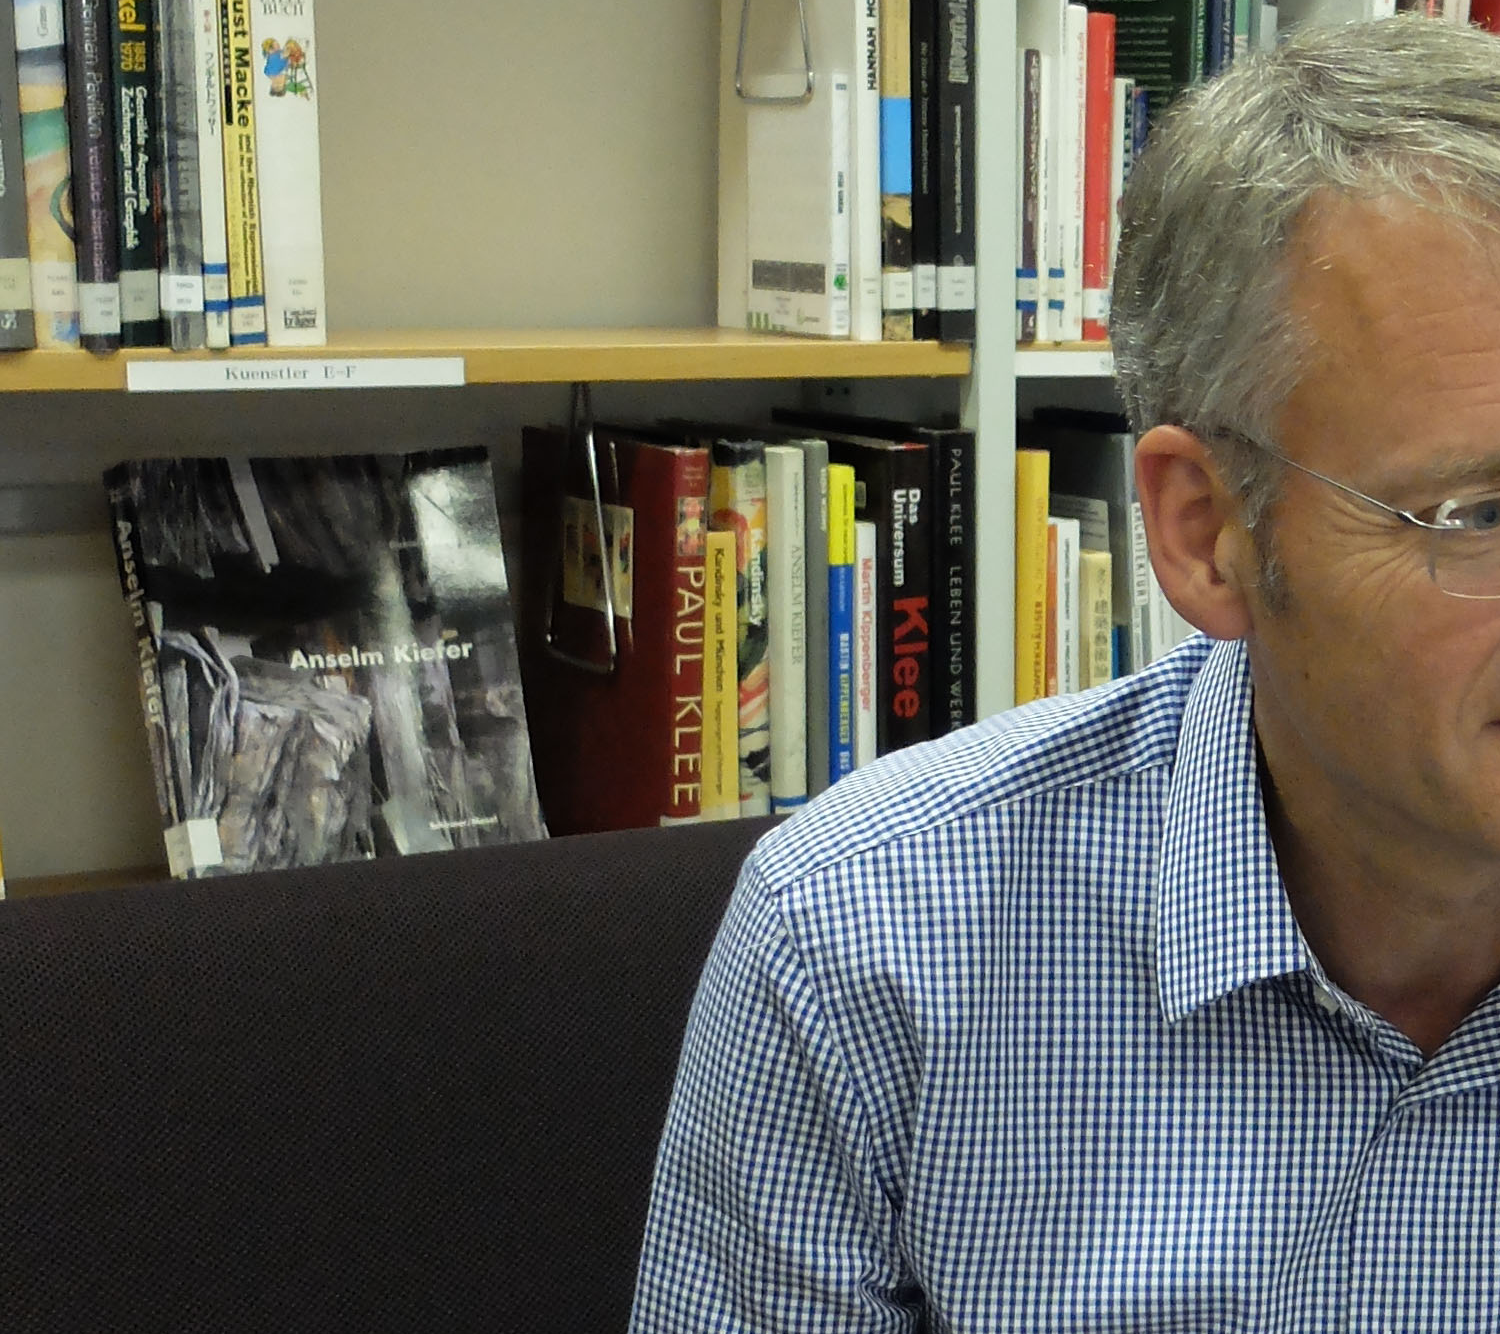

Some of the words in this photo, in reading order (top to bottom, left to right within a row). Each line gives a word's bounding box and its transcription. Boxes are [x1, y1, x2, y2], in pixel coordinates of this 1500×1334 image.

[120, 41, 135, 73] 1970
[866, 26, 878, 91] HANNAH
[135, 85, 150, 146] Gemälde
[234, 46, 253, 128] Macke
[120, 86, 136, 167] Zeichnungen
[123, 169, 137, 194] und
[123, 196, 141, 250] Graphik
[225, 365, 310, 381] Kuenstler
[323, 364, 358, 380] E-F
[949, 447, 963, 497] PAUL
[908, 487, 922, 526] Das
[949, 502, 963, 547] KLEE
[892, 488, 907, 587] Universum
[711, 547, 725, 608] Kandinsky
[749, 527, 765, 627] Kandinsky
[791, 543, 804, 607] ANSELM
[862, 557, 873, 605] Martin
[949, 565, 963, 625] LEBEN
[116, 519, 146, 627] Anselm
[138, 635, 163, 725] Kiefer
[675, 564, 705, 675] PAUL
[714, 611, 726, 635] und
[791, 611, 804, 666] KIEFER
[290, 645, 385, 670] Anselm
[394, 638, 473, 664] Kiefer
[714, 638, 726, 692] München
[838, 632, 850, 670] MARTIN
[860, 610, 873, 713] Kippenberger
[892, 595, 930, 720] Klee
[949, 632, 963, 676] UND
[673, 695, 703, 807] KLEE
